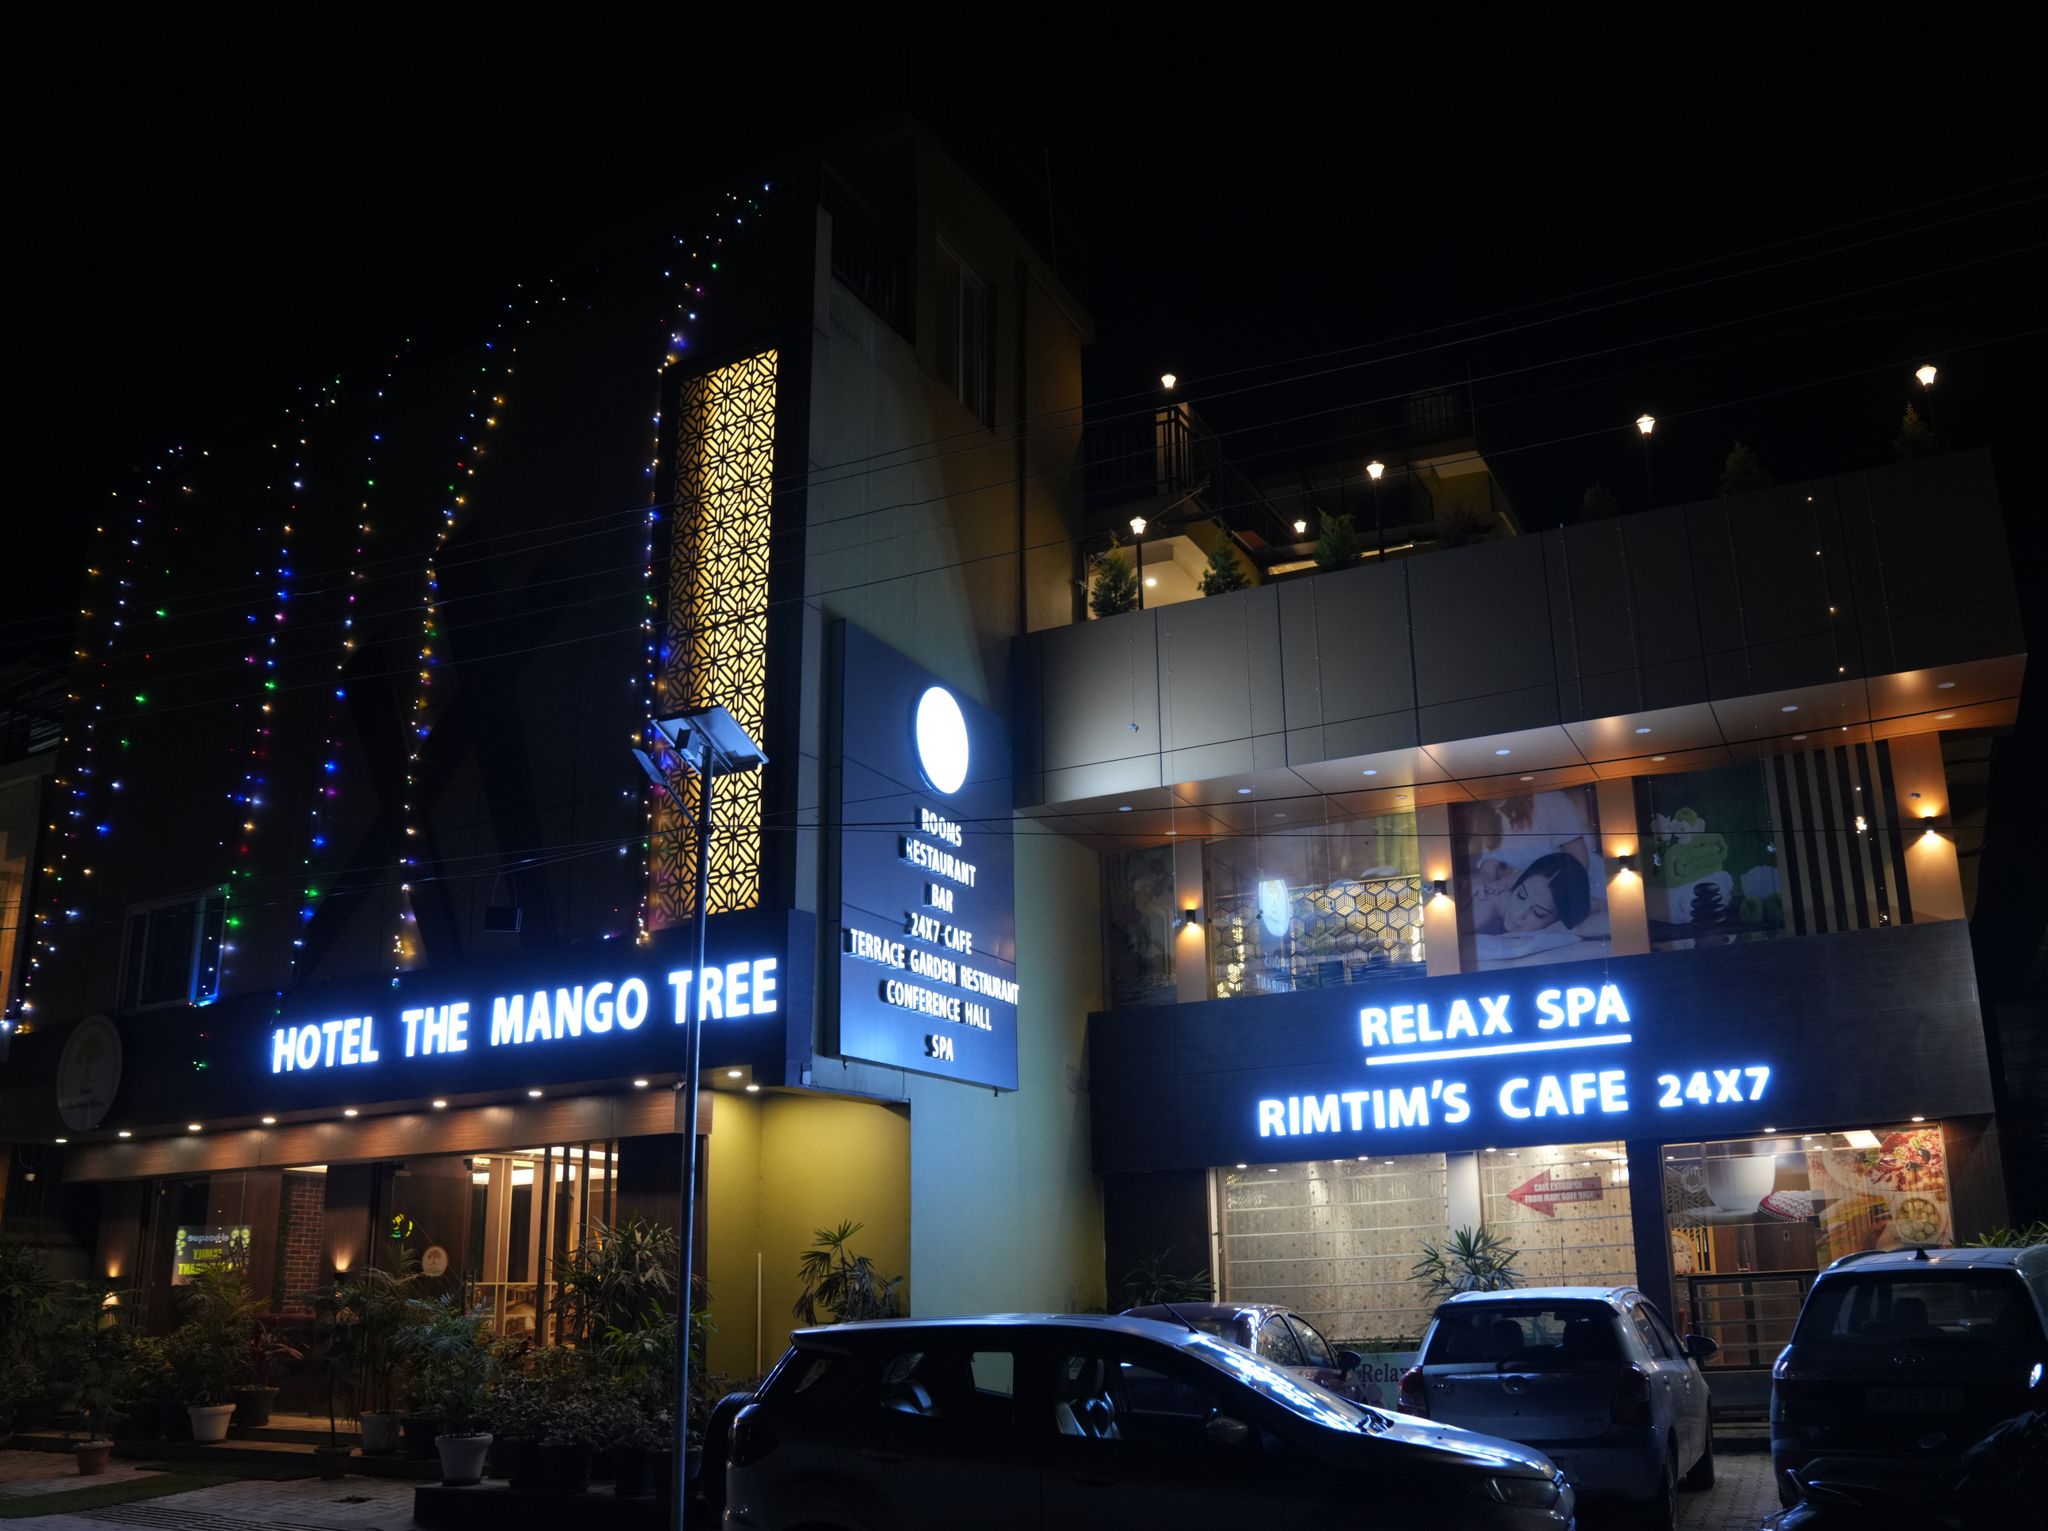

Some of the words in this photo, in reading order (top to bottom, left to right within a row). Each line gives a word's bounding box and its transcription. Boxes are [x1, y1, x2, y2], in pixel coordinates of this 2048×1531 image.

[920, 807, 962, 847] ROOMS
[904, 837, 977, 888] RESTAURANT
[931, 883, 954, 914] BAR
[911, 912, 941, 943] 24X7
[944, 925, 973, 955] CAFE
[850, 928, 906, 969] TERRACE
[910, 948, 957, 985] GARDEN
[960, 966, 1020, 1007] RESTAURANT
[272, 1016, 380, 1074] HOTEL
[402, 1002, 470, 1058] THE
[490, 978, 649, 1047] MANGO
[668, 957, 777, 1025] TREE
[886, 979, 961, 1022] CONFERENCE
[965, 1001, 992, 1031] HALL
[1359, 994, 1513, 1048] RELAX
[1535, 983, 1631, 1030] SPA
[931, 1034, 954, 1062] SPA
[1258, 1079, 1471, 1138] RIMTIM'S
[1498, 1069, 1629, 1119] CAFE
[1657, 1067, 1771, 1108] 24X7
[1525, 1193, 1543, 1204] FROM
[1533, 1182, 1549, 1192] CAFE
